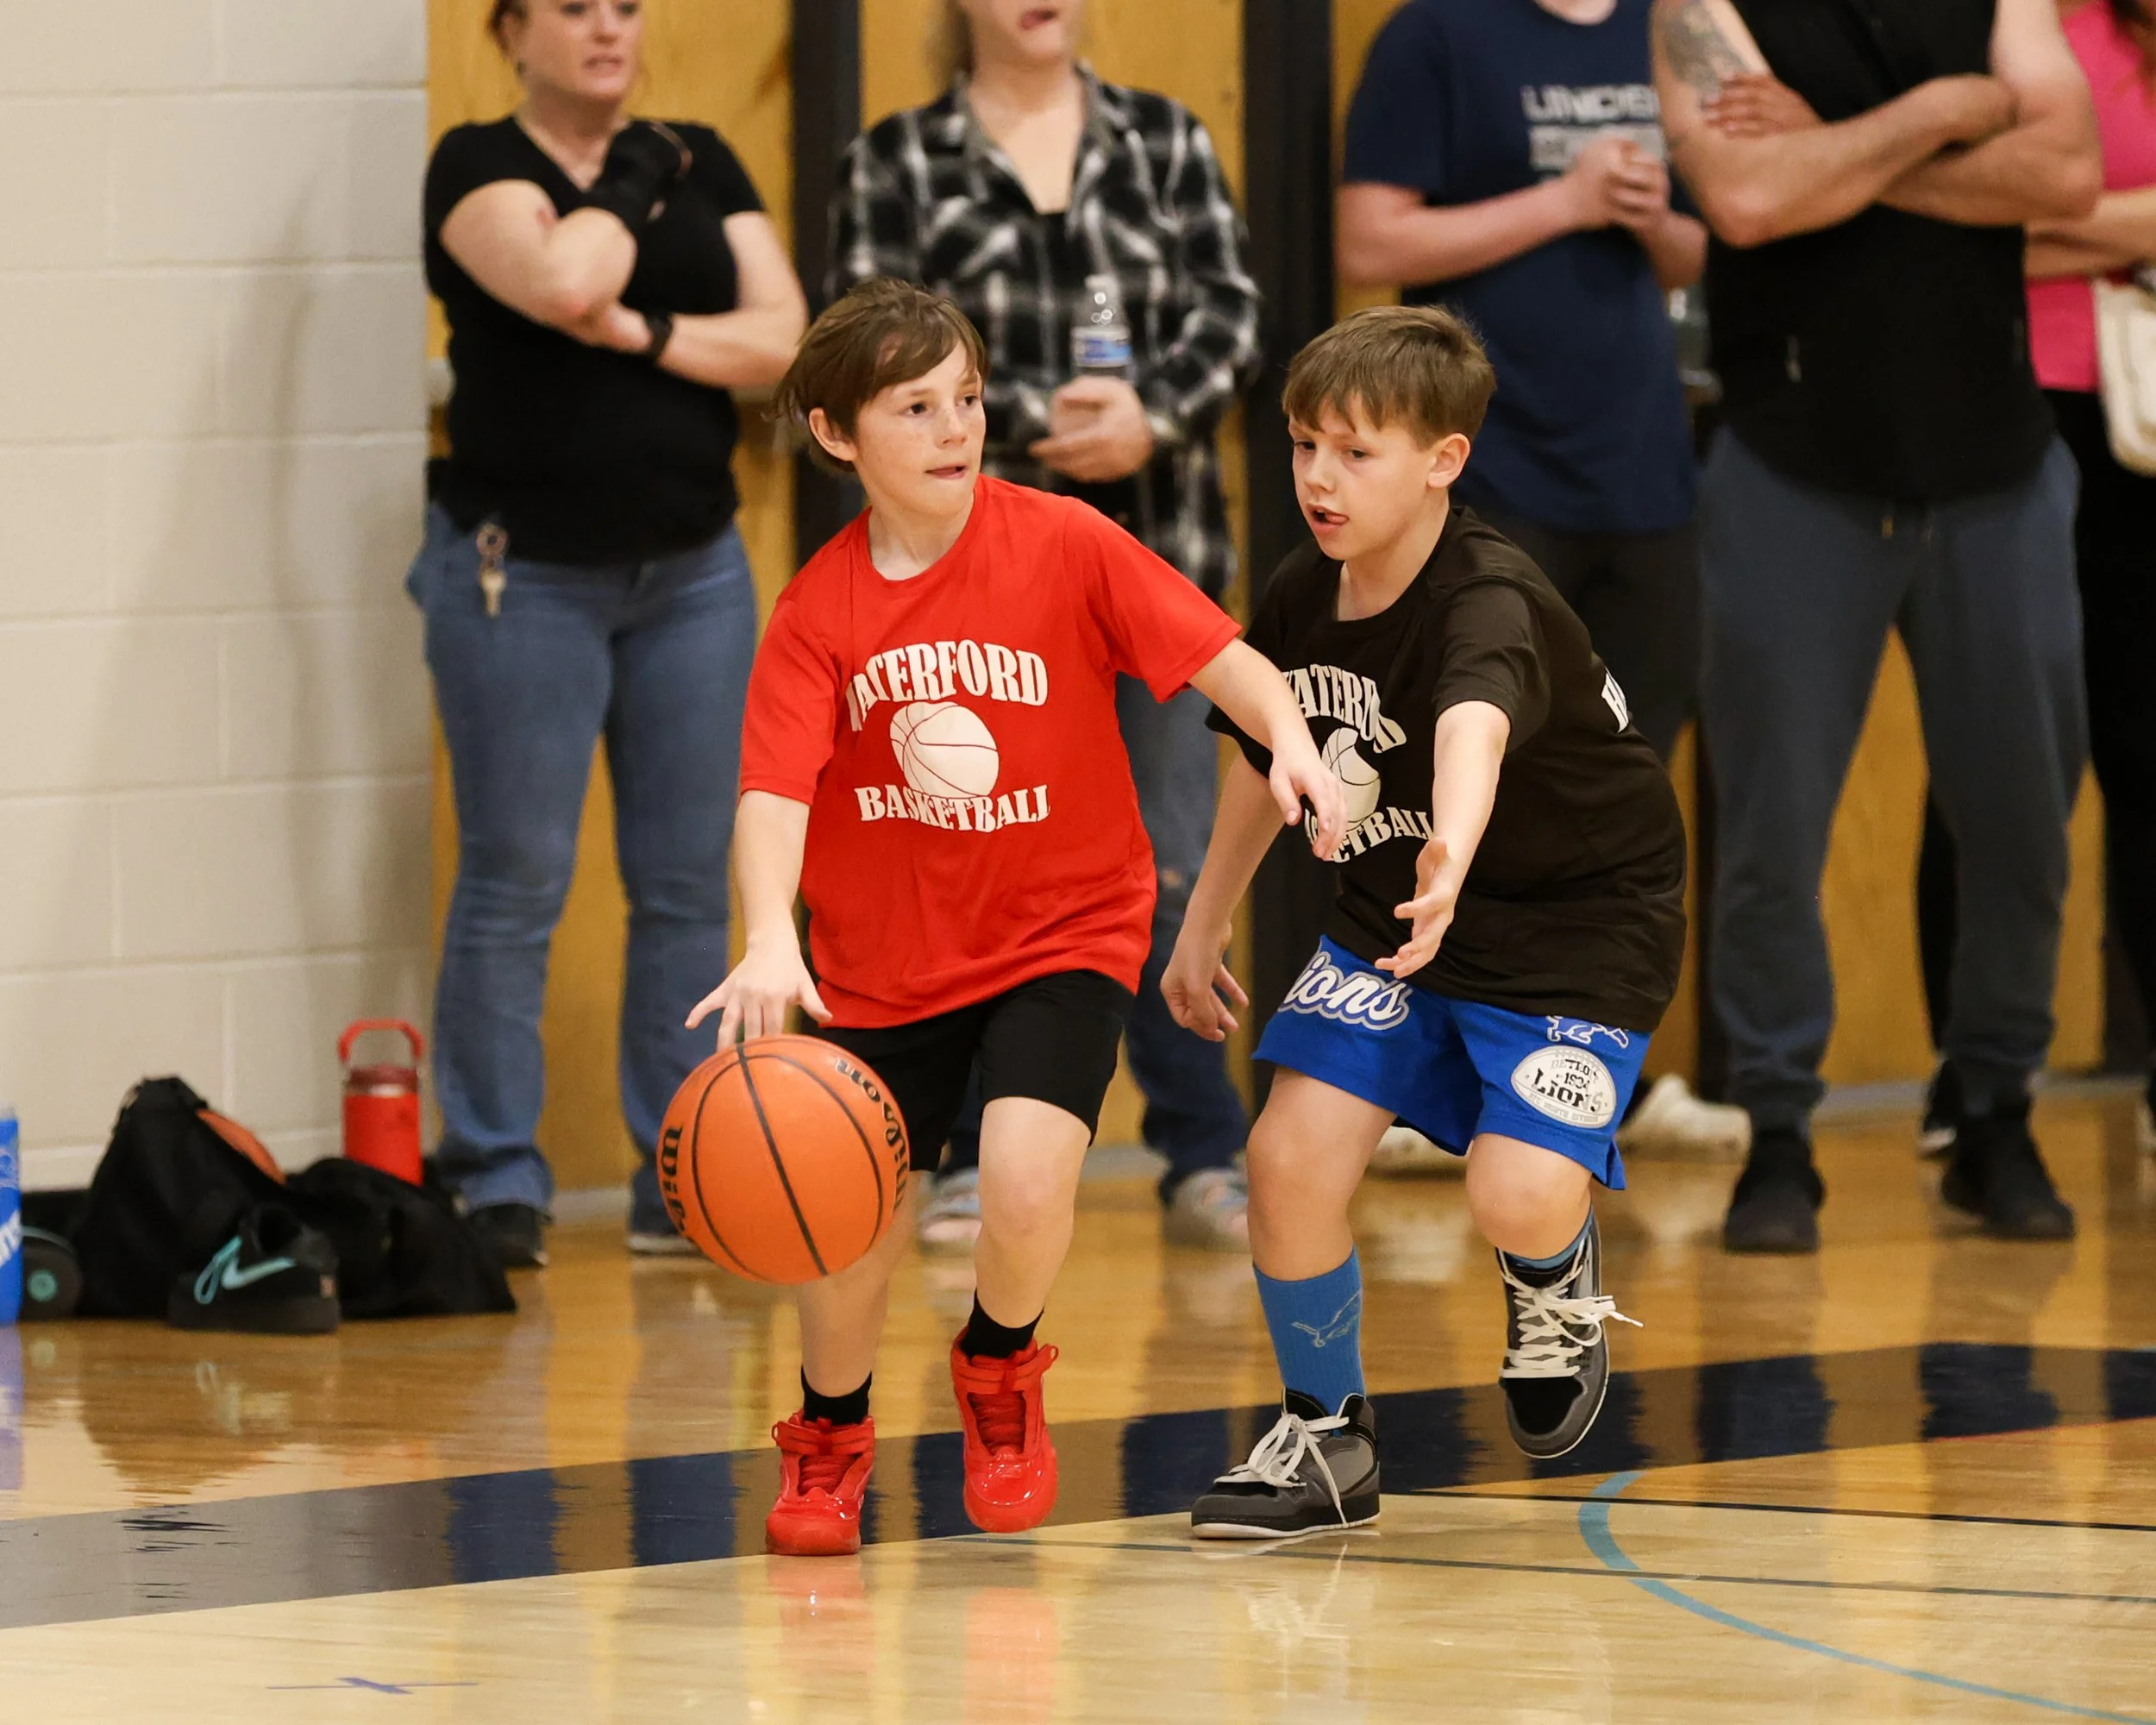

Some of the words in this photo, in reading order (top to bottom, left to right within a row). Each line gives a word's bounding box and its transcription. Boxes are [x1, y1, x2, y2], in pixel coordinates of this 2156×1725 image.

[855, 784, 1050, 833] BASKETBALL
[1281, 953, 1410, 1026] ions
[1532, 1068, 1604, 1113] LIONS
